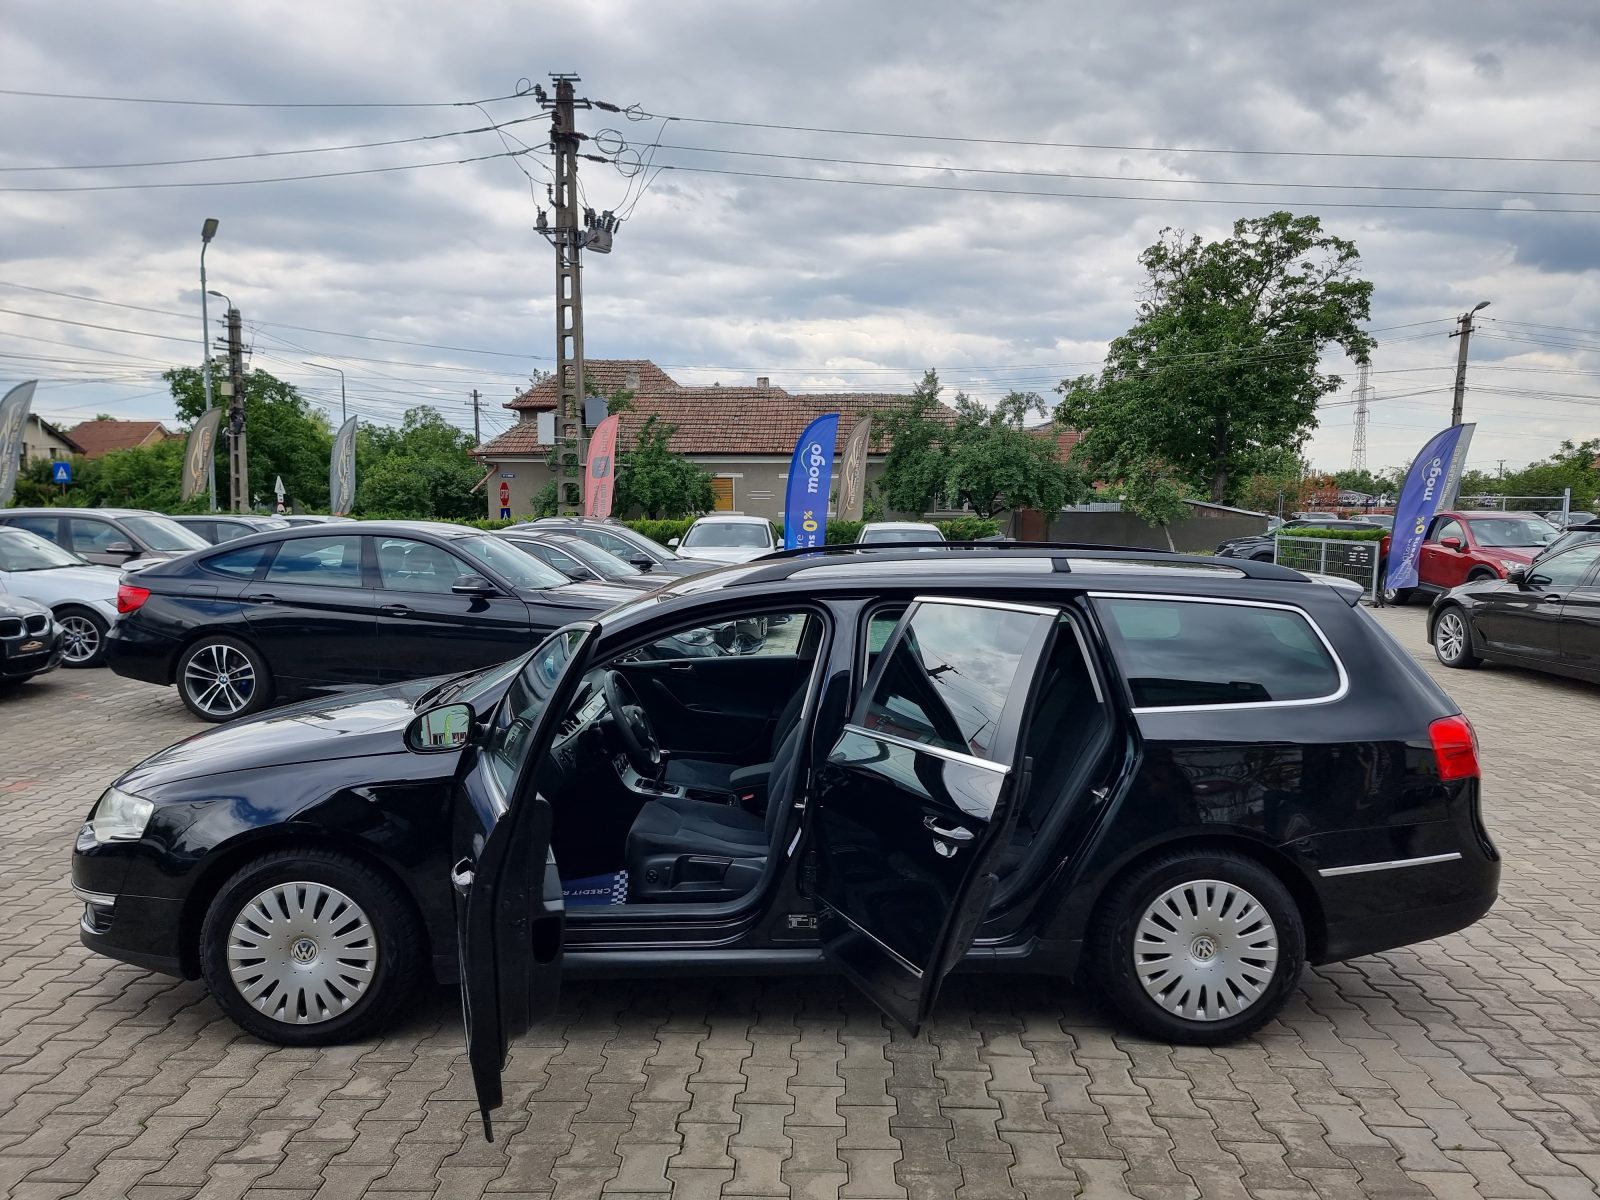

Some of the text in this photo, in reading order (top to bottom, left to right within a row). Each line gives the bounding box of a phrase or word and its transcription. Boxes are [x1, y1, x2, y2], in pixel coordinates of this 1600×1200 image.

[807, 443, 826, 494] mogo
[1423, 457, 1442, 501] mogo
[571, 887, 611, 896] CREDIT
